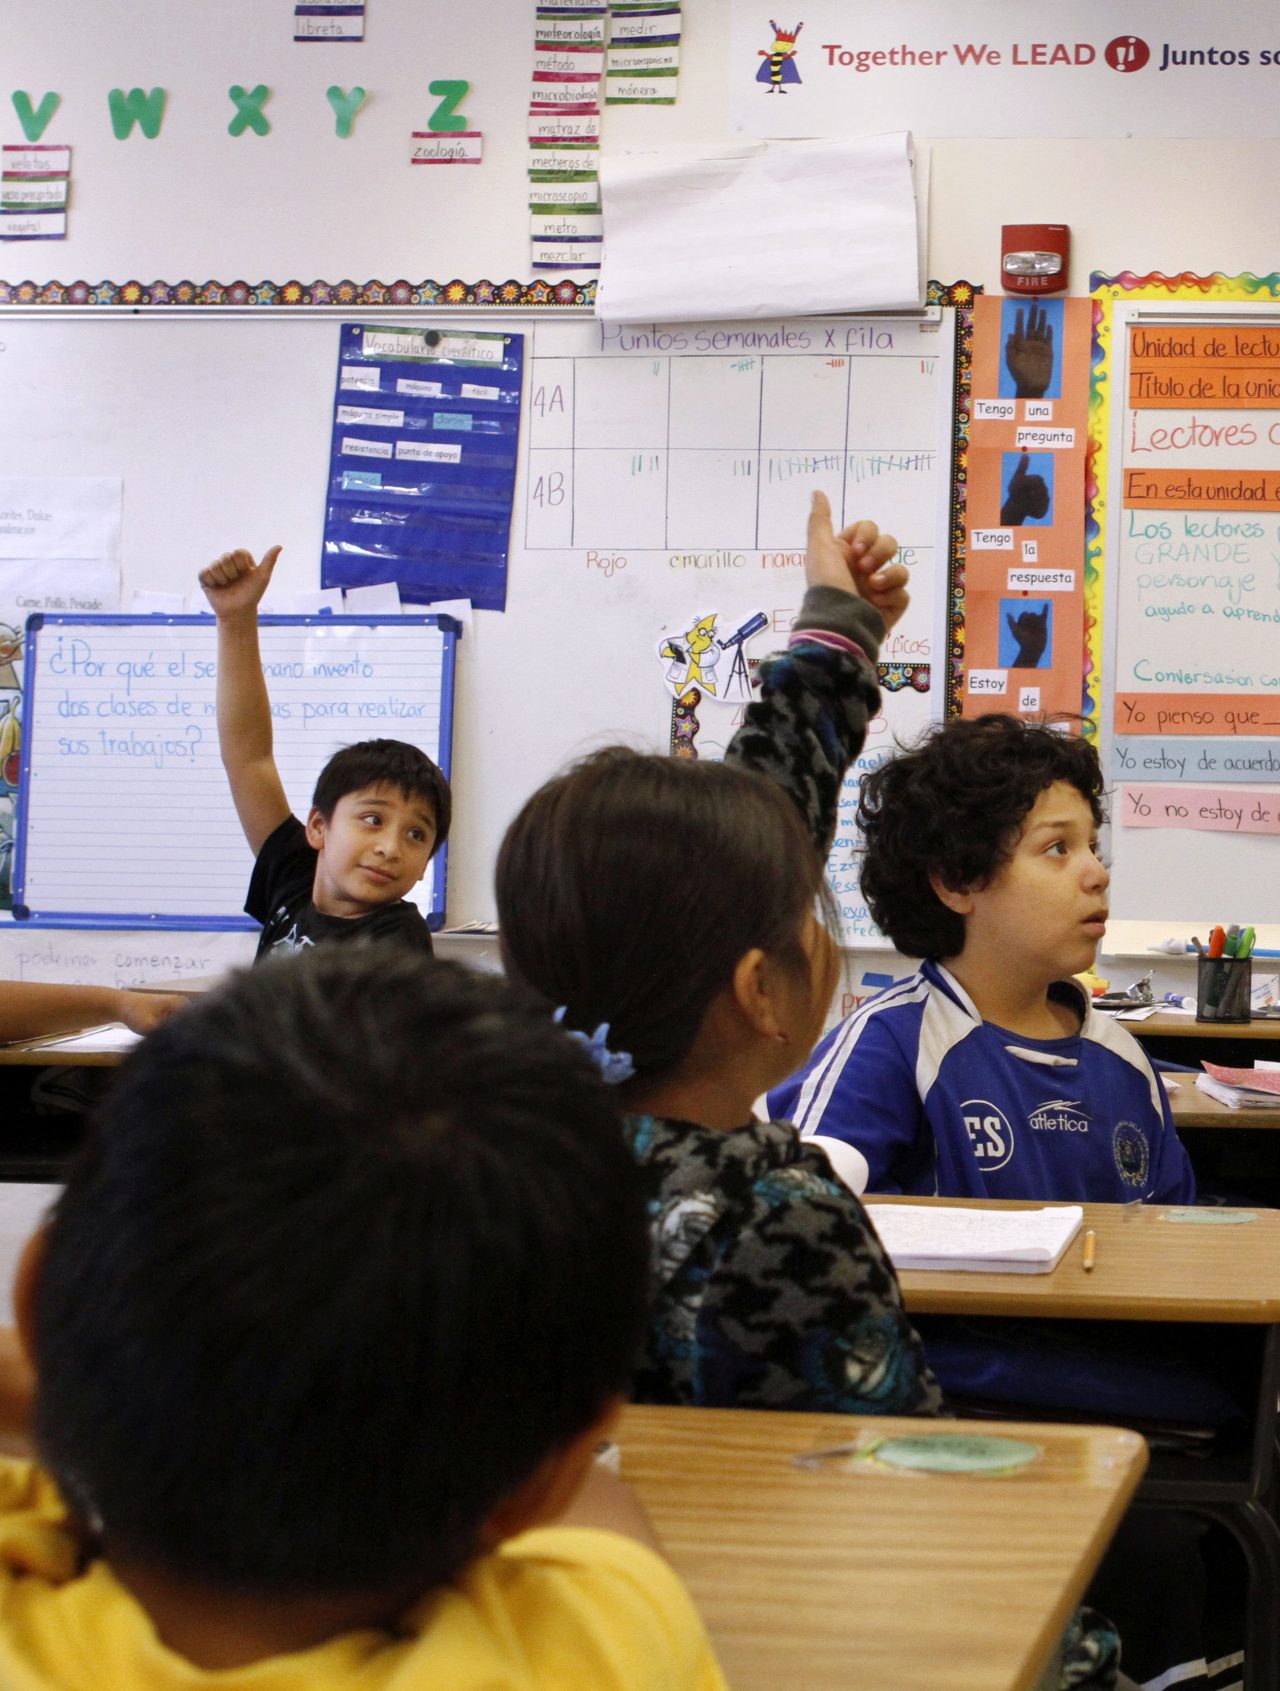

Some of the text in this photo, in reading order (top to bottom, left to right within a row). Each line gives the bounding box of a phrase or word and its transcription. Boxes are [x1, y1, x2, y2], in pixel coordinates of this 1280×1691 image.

[296, 18, 344, 36] libreta
[619, 19, 657, 36] medir
[822, 44, 1096, 71] Together We LEAD
[1160, 44, 1250, 71] Juntos
[11, 89, 61, 142] V
[108, 87, 167, 140] W
[228, 84, 270, 137] X
[326, 85, 367, 138] Y
[427, 79, 470, 132] Z
[586, 119, 597, 135] de
[413, 140, 469, 162] zoología
[529, 191, 589, 207] microscopio
[544, 217, 578, 234] metro
[540, 245, 586, 262] mezclar
[1017, 276, 1049, 287] FIRE
[600, 319, 688, 351] Puntos
[695, 325, 812, 350] semanales
[845, 327, 894, 350] fila
[1132, 331, 1194, 358] Unidad
[1203, 332, 1226, 357] de
[1131, 371, 1185, 399] Título
[1189, 375, 1216, 399] de
[1222, 375, 1241, 399] la
[532, 385, 565, 418] 4A
[976, 402, 1050, 418] Tengo una
[1018, 430, 1073, 445] pregunta
[1131, 410, 1257, 453] Lectores
[422, 448, 434, 457] de
[531, 471, 566, 510] 4B
[1128, 472, 1158, 499] En
[1165, 477, 1202, 499] esta
[1206, 477, 1267, 501] unidad
[1128, 509, 1172, 540] Los
[1185, 515, 1265, 540] lectores
[974, 532, 1036, 556] Tengo la
[1135, 541, 1251, 565] GRANDE
[586, 551, 627, 578] Rojo
[1010, 572, 1073, 584] respuesta
[1136, 572, 1257, 606] personaje
[1202, 605, 1214, 614] a
[49, 635, 374, 697] ¿Por qué el invento
[970, 676, 1005, 692] Estoy
[58, 690, 90, 718] dos
[97, 692, 158, 717] clases
[167, 691, 192, 717] de
[303, 702, 349, 729] para
[357, 696, 427, 718] realizar
[1022, 696, 1037, 707] de
[1123, 700, 1146, 724] Yo
[1157, 709, 1215, 733] pienso
[1225, 710, 1261, 734] que
[99, 725, 203, 768] trabajos?
[1115, 747, 1137, 770] Yo
[1143, 748, 1187, 778] estoy
[1197, 749, 1218, 770] de
[1127, 792, 1152, 817] Yo
[1165, 803, 1190, 818] no
[1199, 797, 1244, 830] estoy
[1251, 801, 1271, 823] de
[114, 951, 211, 970] comenzar
[963, 1116, 1005, 1157] ES
[1029, 1114, 1088, 1133] atletica
